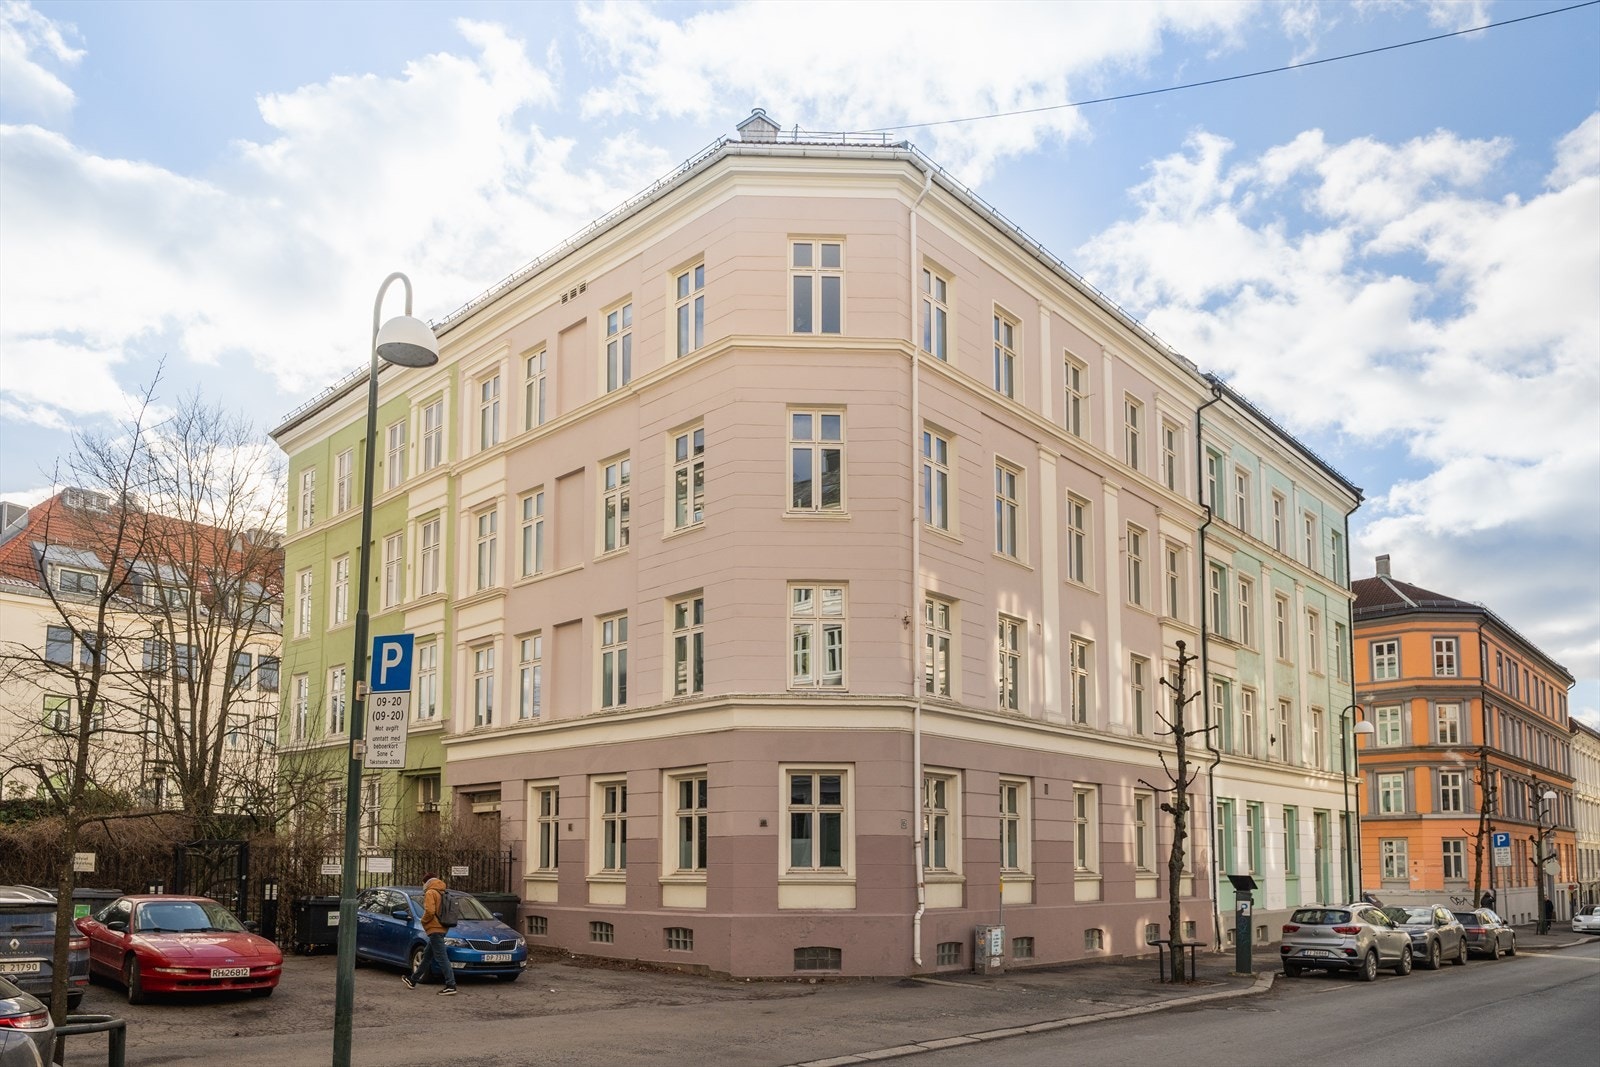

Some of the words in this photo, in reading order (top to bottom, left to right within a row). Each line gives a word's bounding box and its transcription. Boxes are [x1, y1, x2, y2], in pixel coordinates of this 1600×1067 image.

[380, 642, 403, 684] P
[1497, 834, 1506, 846] P
[10, 963, 37, 971] 21790
